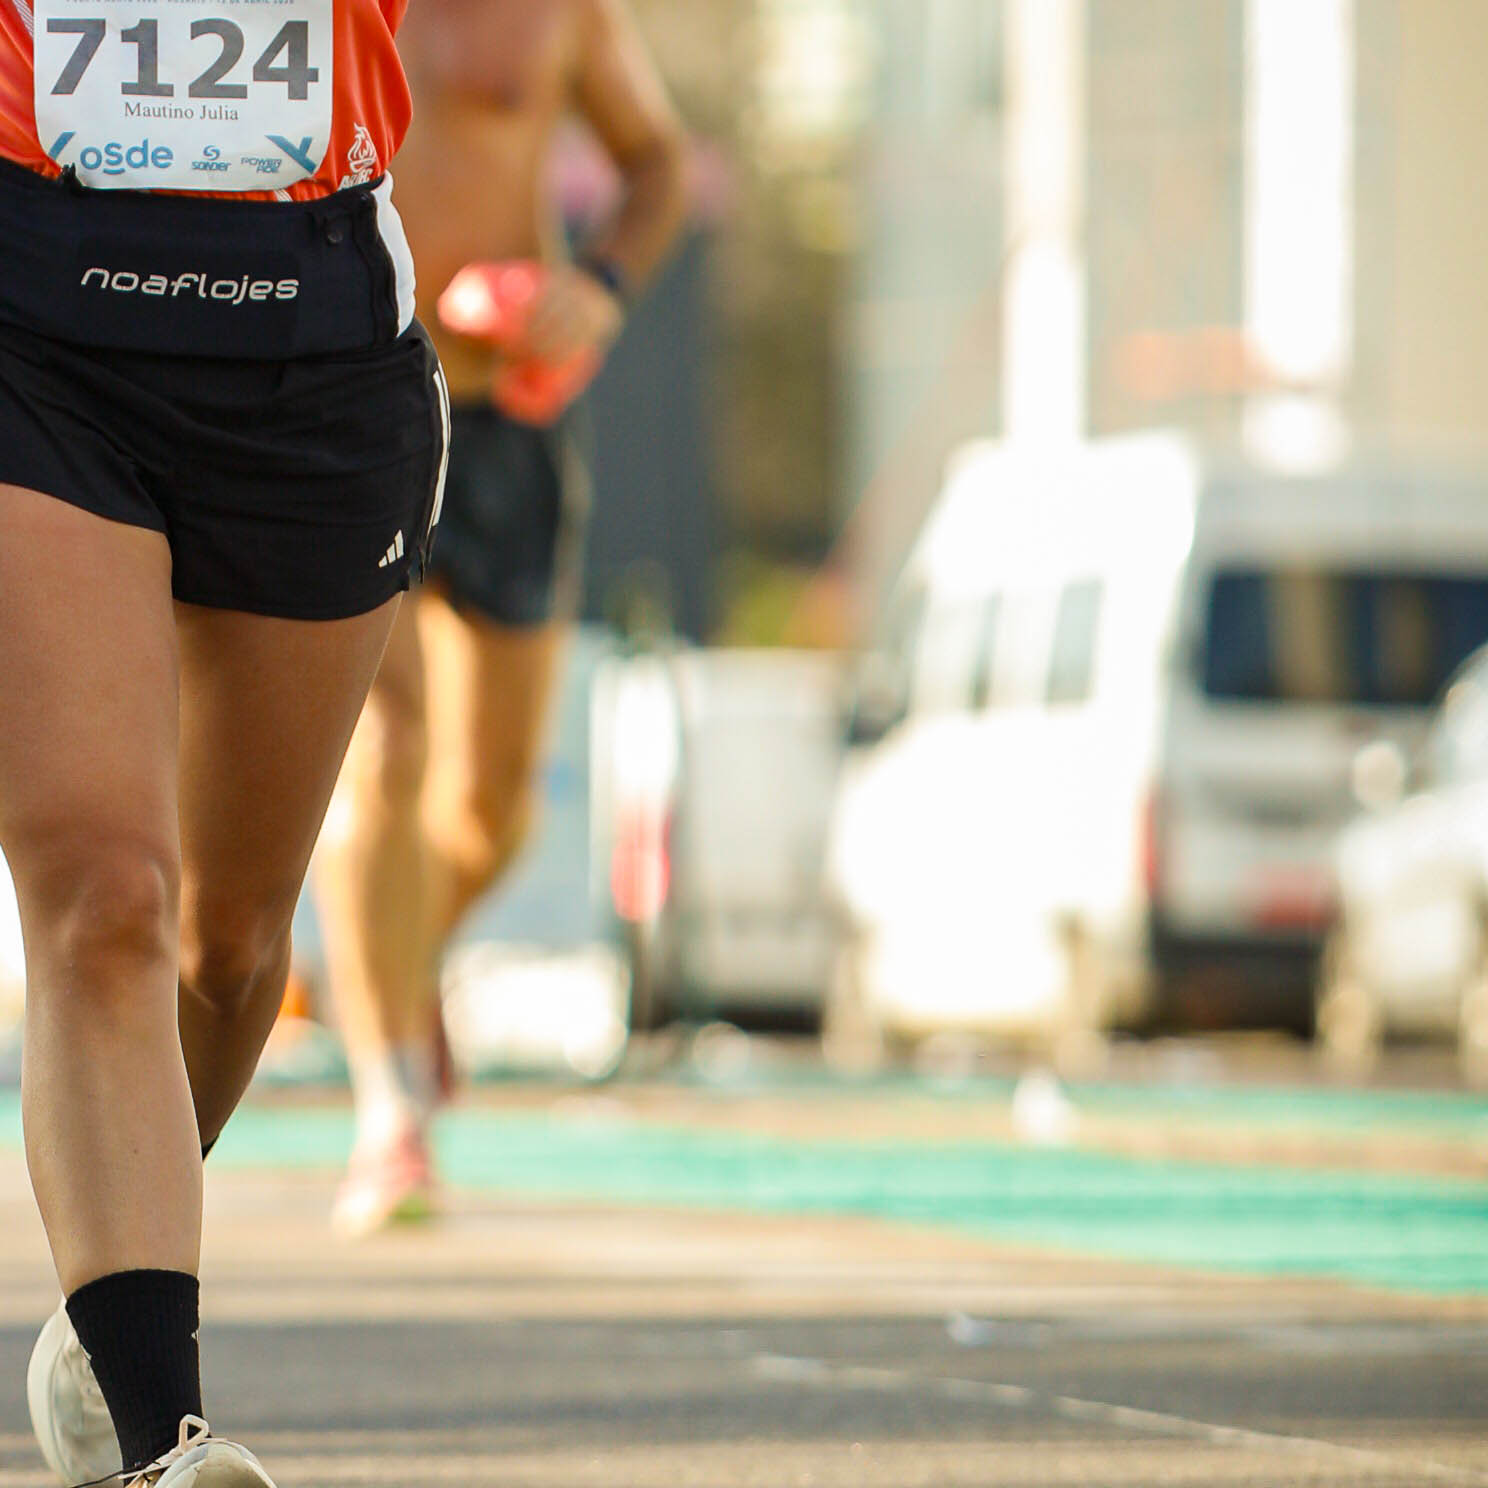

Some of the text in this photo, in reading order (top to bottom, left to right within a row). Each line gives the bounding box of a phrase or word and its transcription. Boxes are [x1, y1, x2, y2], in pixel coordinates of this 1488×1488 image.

[46, 17, 320, 101] 7124
[124, 101, 239, 121] Mautino Julia
[79, 137, 174, 171] osde
[80, 267, 300, 305] noaflojes
